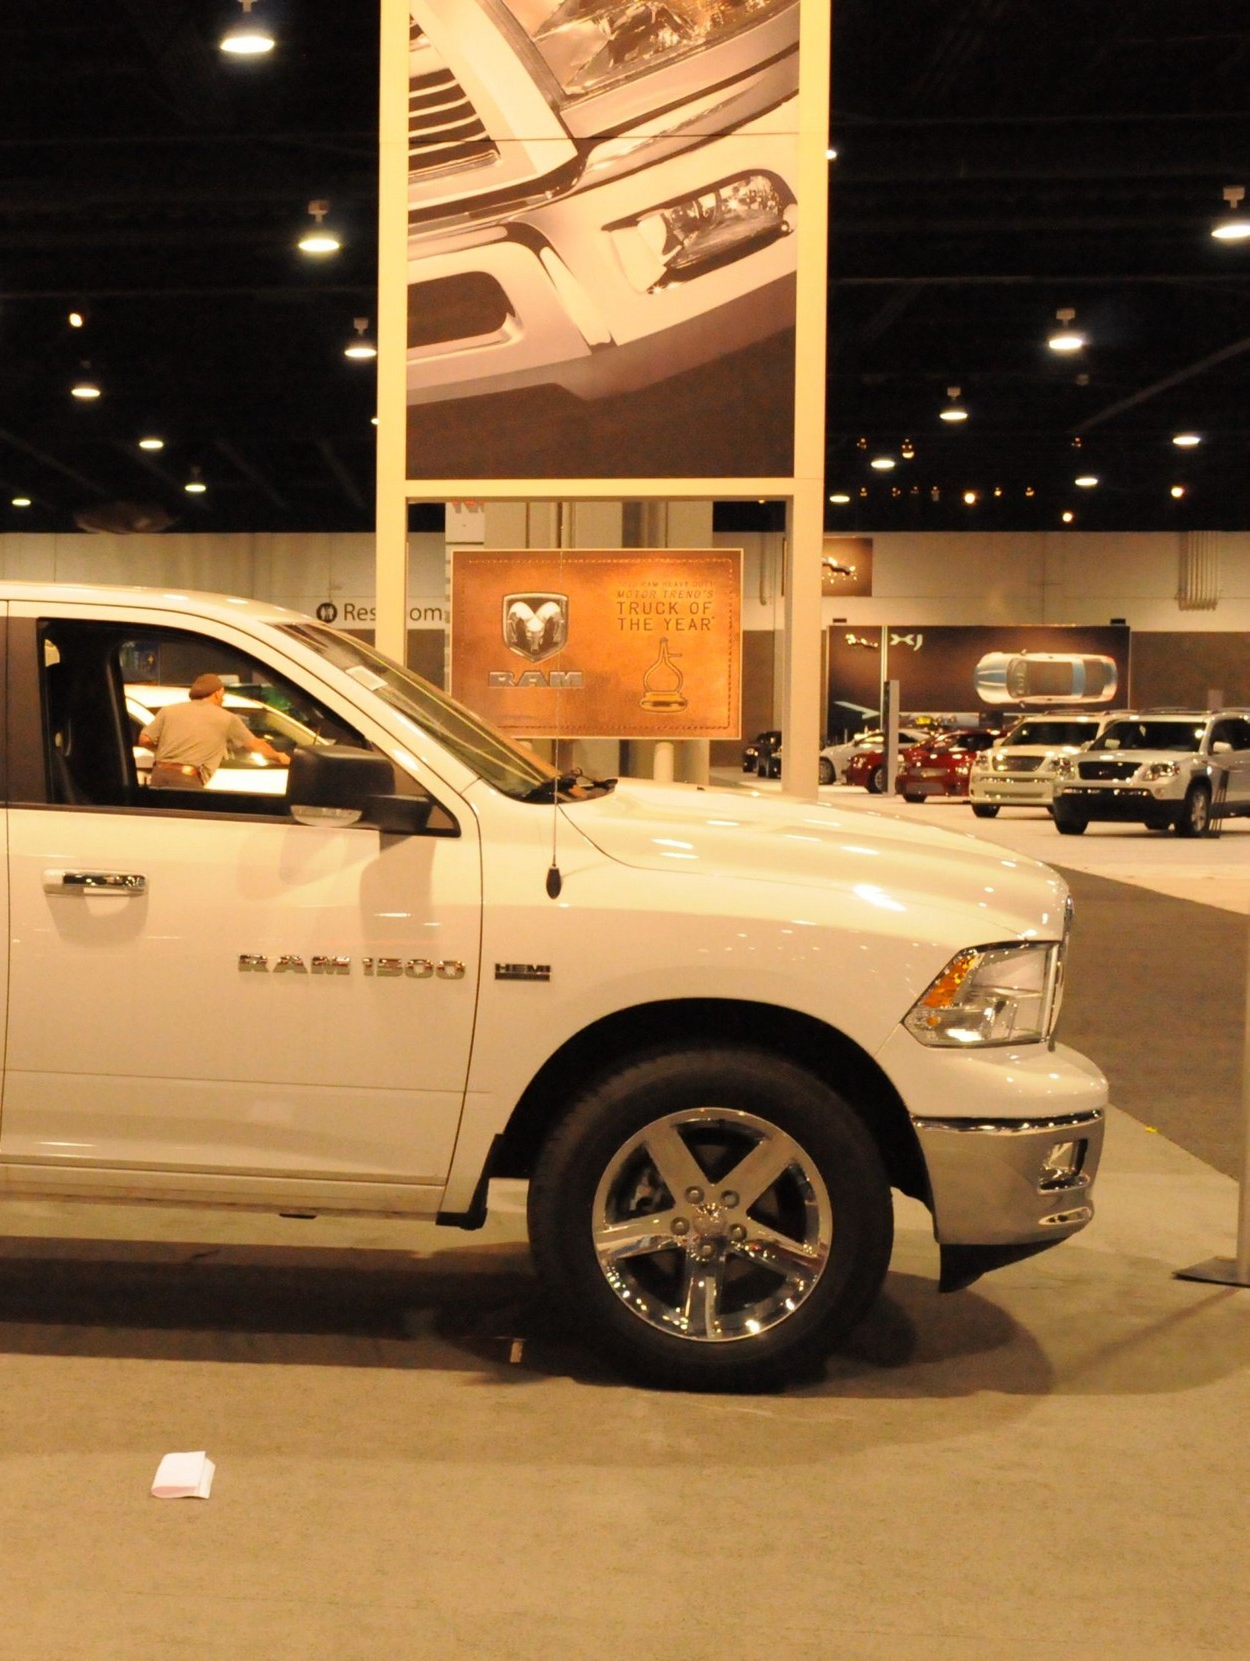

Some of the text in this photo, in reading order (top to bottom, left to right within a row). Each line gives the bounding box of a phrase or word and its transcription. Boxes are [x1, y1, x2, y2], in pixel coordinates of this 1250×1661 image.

[616, 589, 715, 600] MOTOR TREND'S
[343, 602, 443, 622] Resom
[616, 601, 713, 616] TRUCK OF
[617, 617, 653, 632] THE
[890, 633, 923, 652] XJ
[488, 670, 583, 688] RAM
[237, 953, 467, 981] RAM 1500
[494, 963, 552, 975] HEMI
